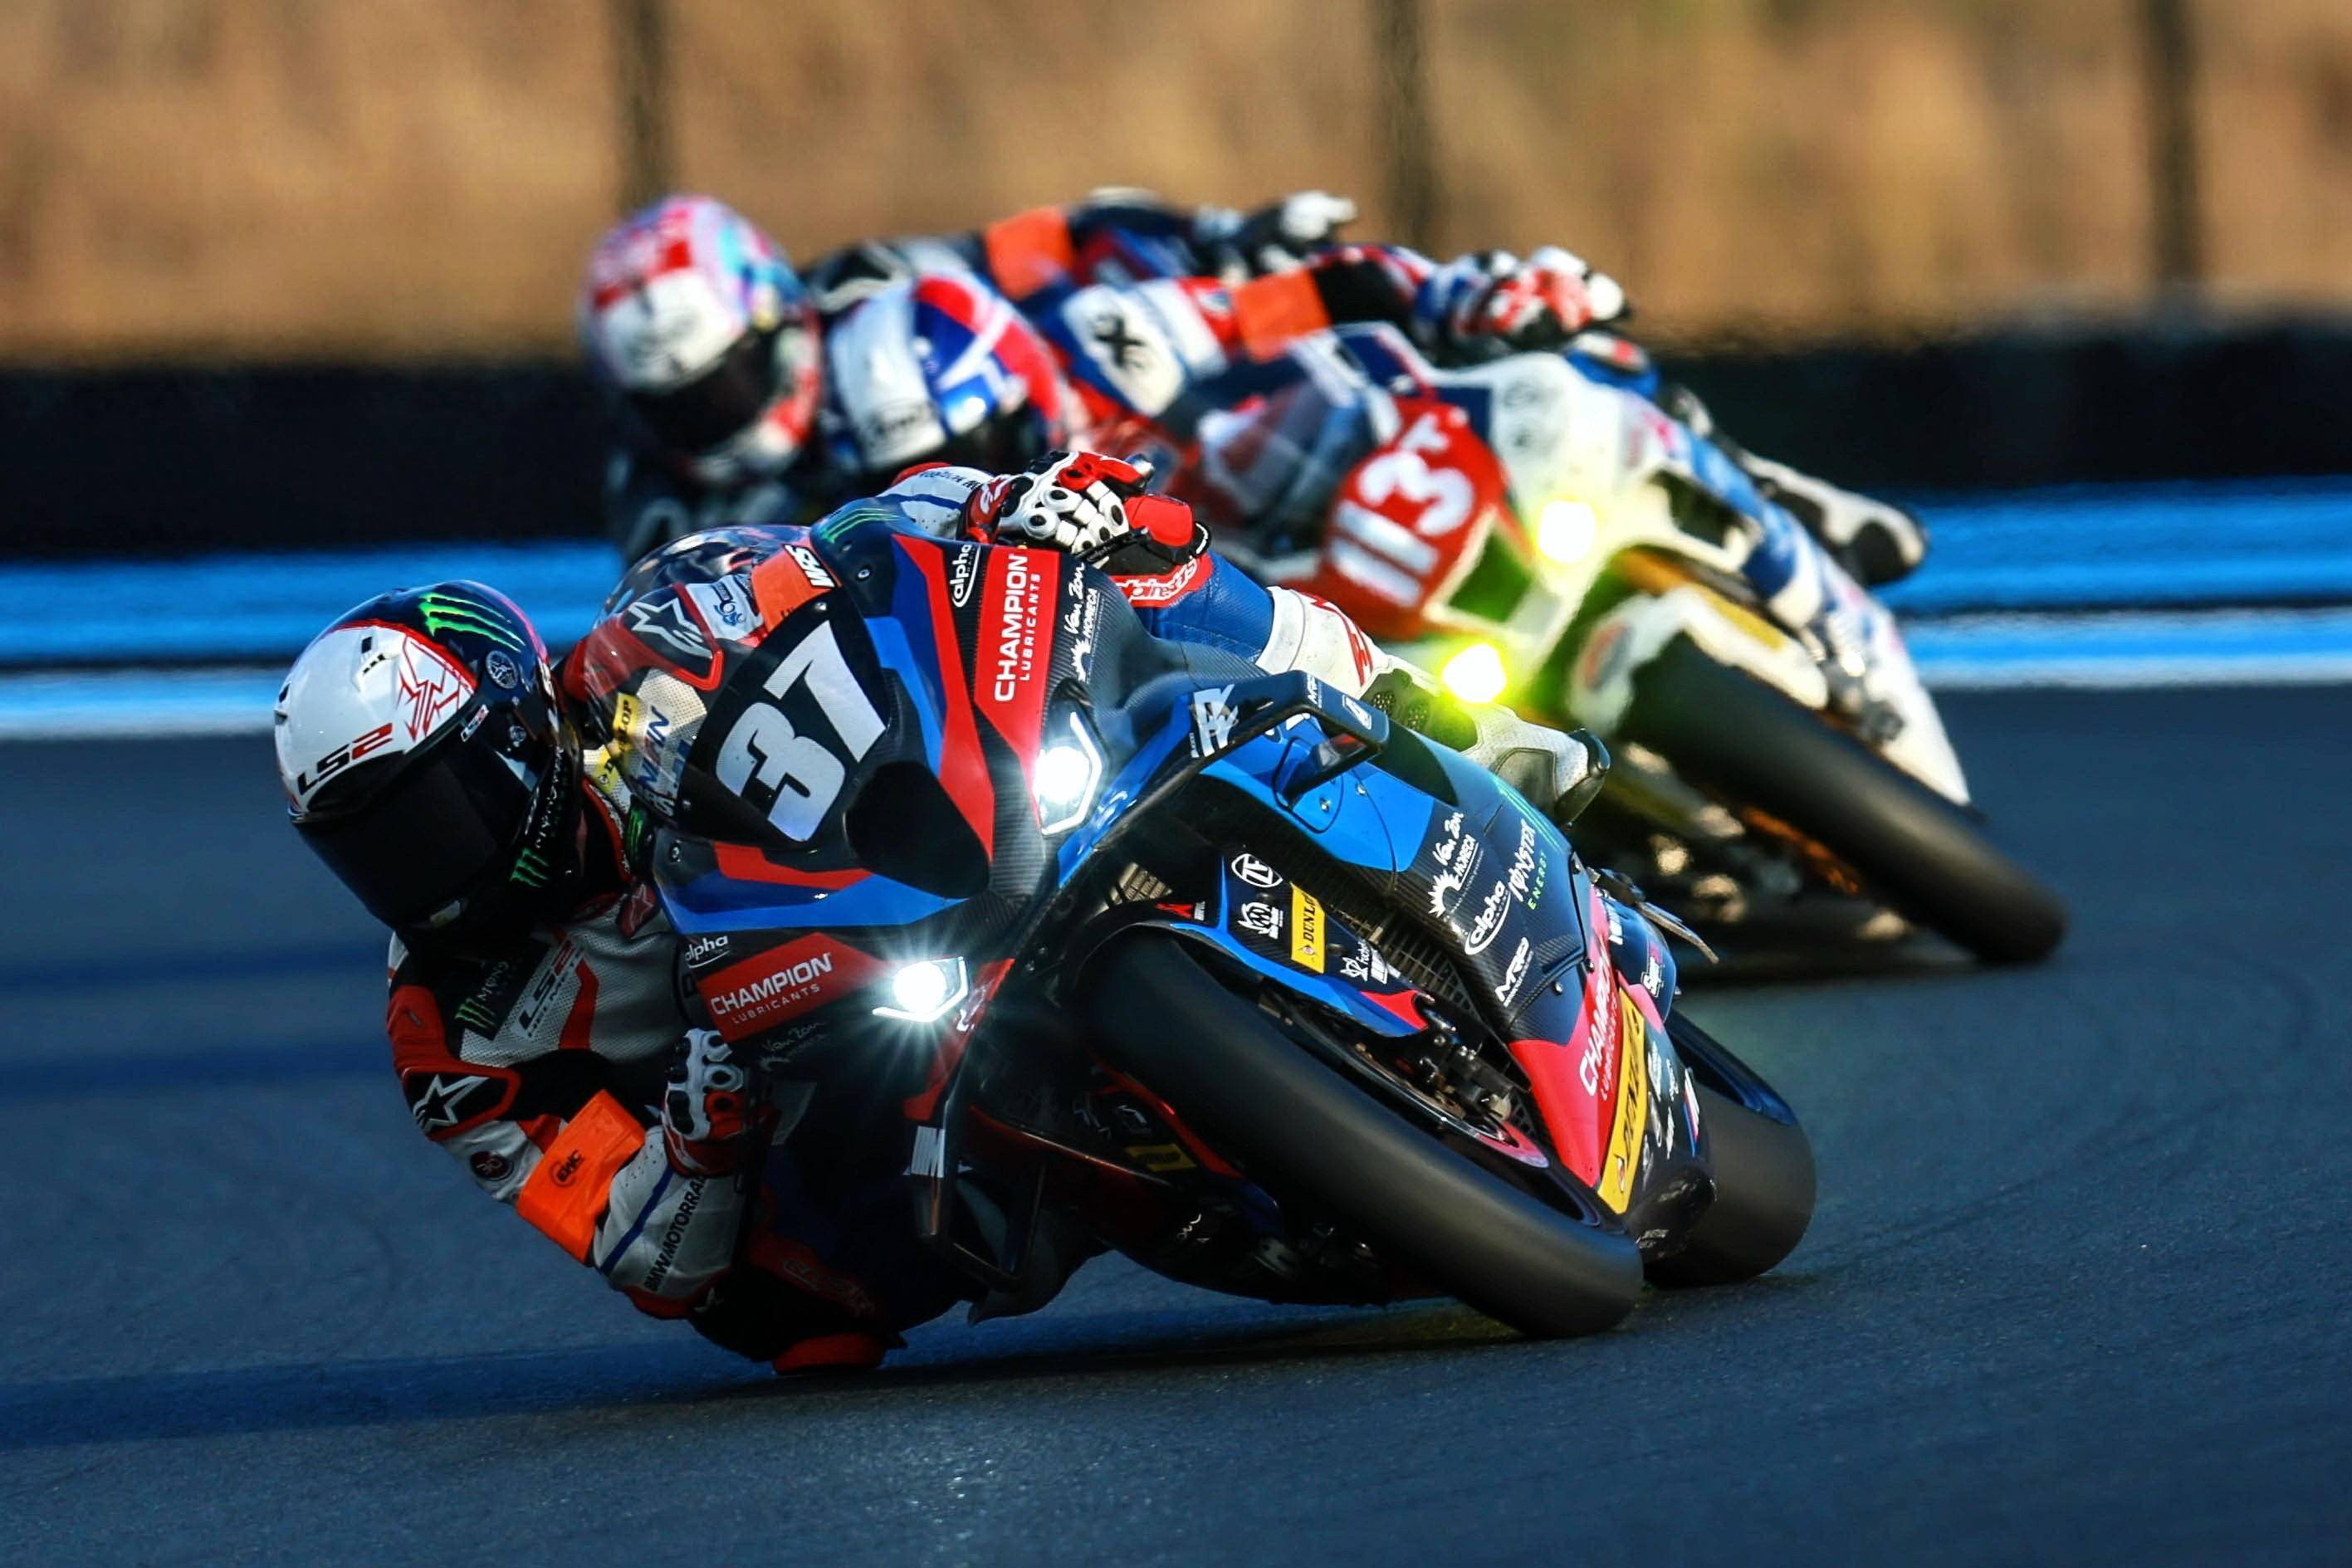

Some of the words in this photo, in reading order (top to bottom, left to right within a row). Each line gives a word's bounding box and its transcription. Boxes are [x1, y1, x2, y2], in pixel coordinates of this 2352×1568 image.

[951, 544, 972, 593] alpha
[1068, 562, 1085, 599] Zon
[993, 554, 1029, 701] CHAMPION
[1019, 573, 1041, 681] LUBRICANTS
[1064, 603, 1083, 634] Van
[715, 619, 887, 843] 37
[297, 723, 394, 795] LS2
[1242, 855, 1274, 885] ZF
[1432, 838, 1457, 866] Van
[1453, 833, 1476, 877] HORECA
[1302, 891, 1317, 944] DUNLO
[1470, 881, 1506, 944] alpha
[685, 934, 729, 964] alpha
[1495, 936, 1529, 1003] MRP
[519, 939, 576, 1031] LS2
[710, 952, 833, 1016] CHAMPION
[731, 982, 821, 1025] LUBRICANTS
